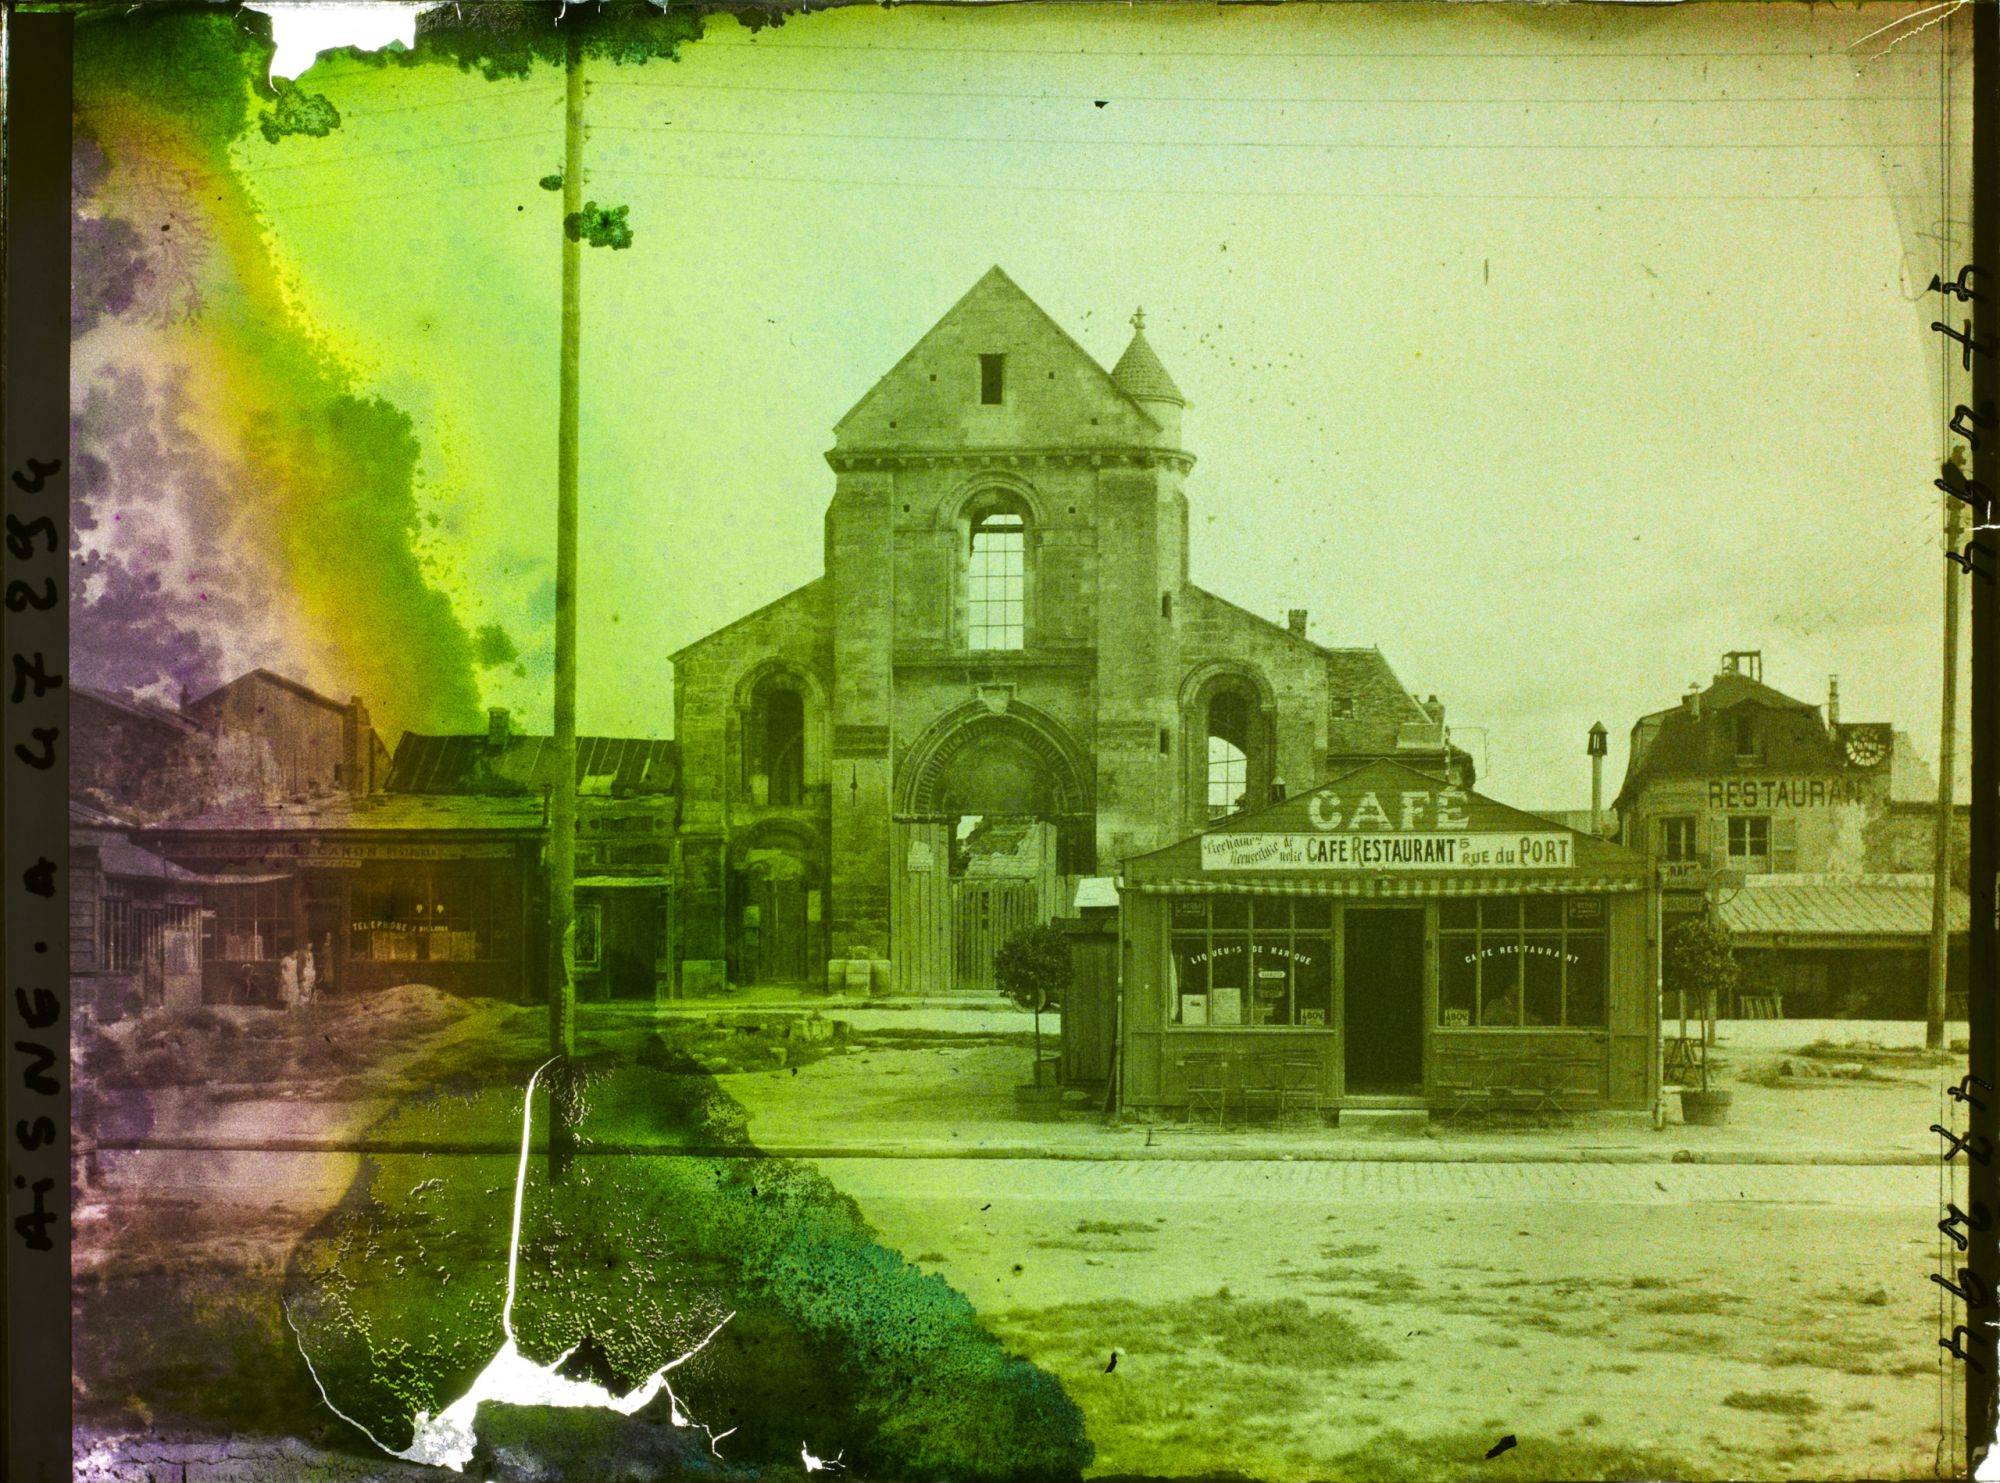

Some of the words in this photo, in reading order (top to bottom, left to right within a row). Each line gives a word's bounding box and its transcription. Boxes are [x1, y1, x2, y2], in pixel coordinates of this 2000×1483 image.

[1351, 837, 1456, 864] RESTAURANT
[1462, 850, 1490, 866] RUE
[1495, 847, 1515, 864] du
[1519, 836, 1569, 865] PORT
